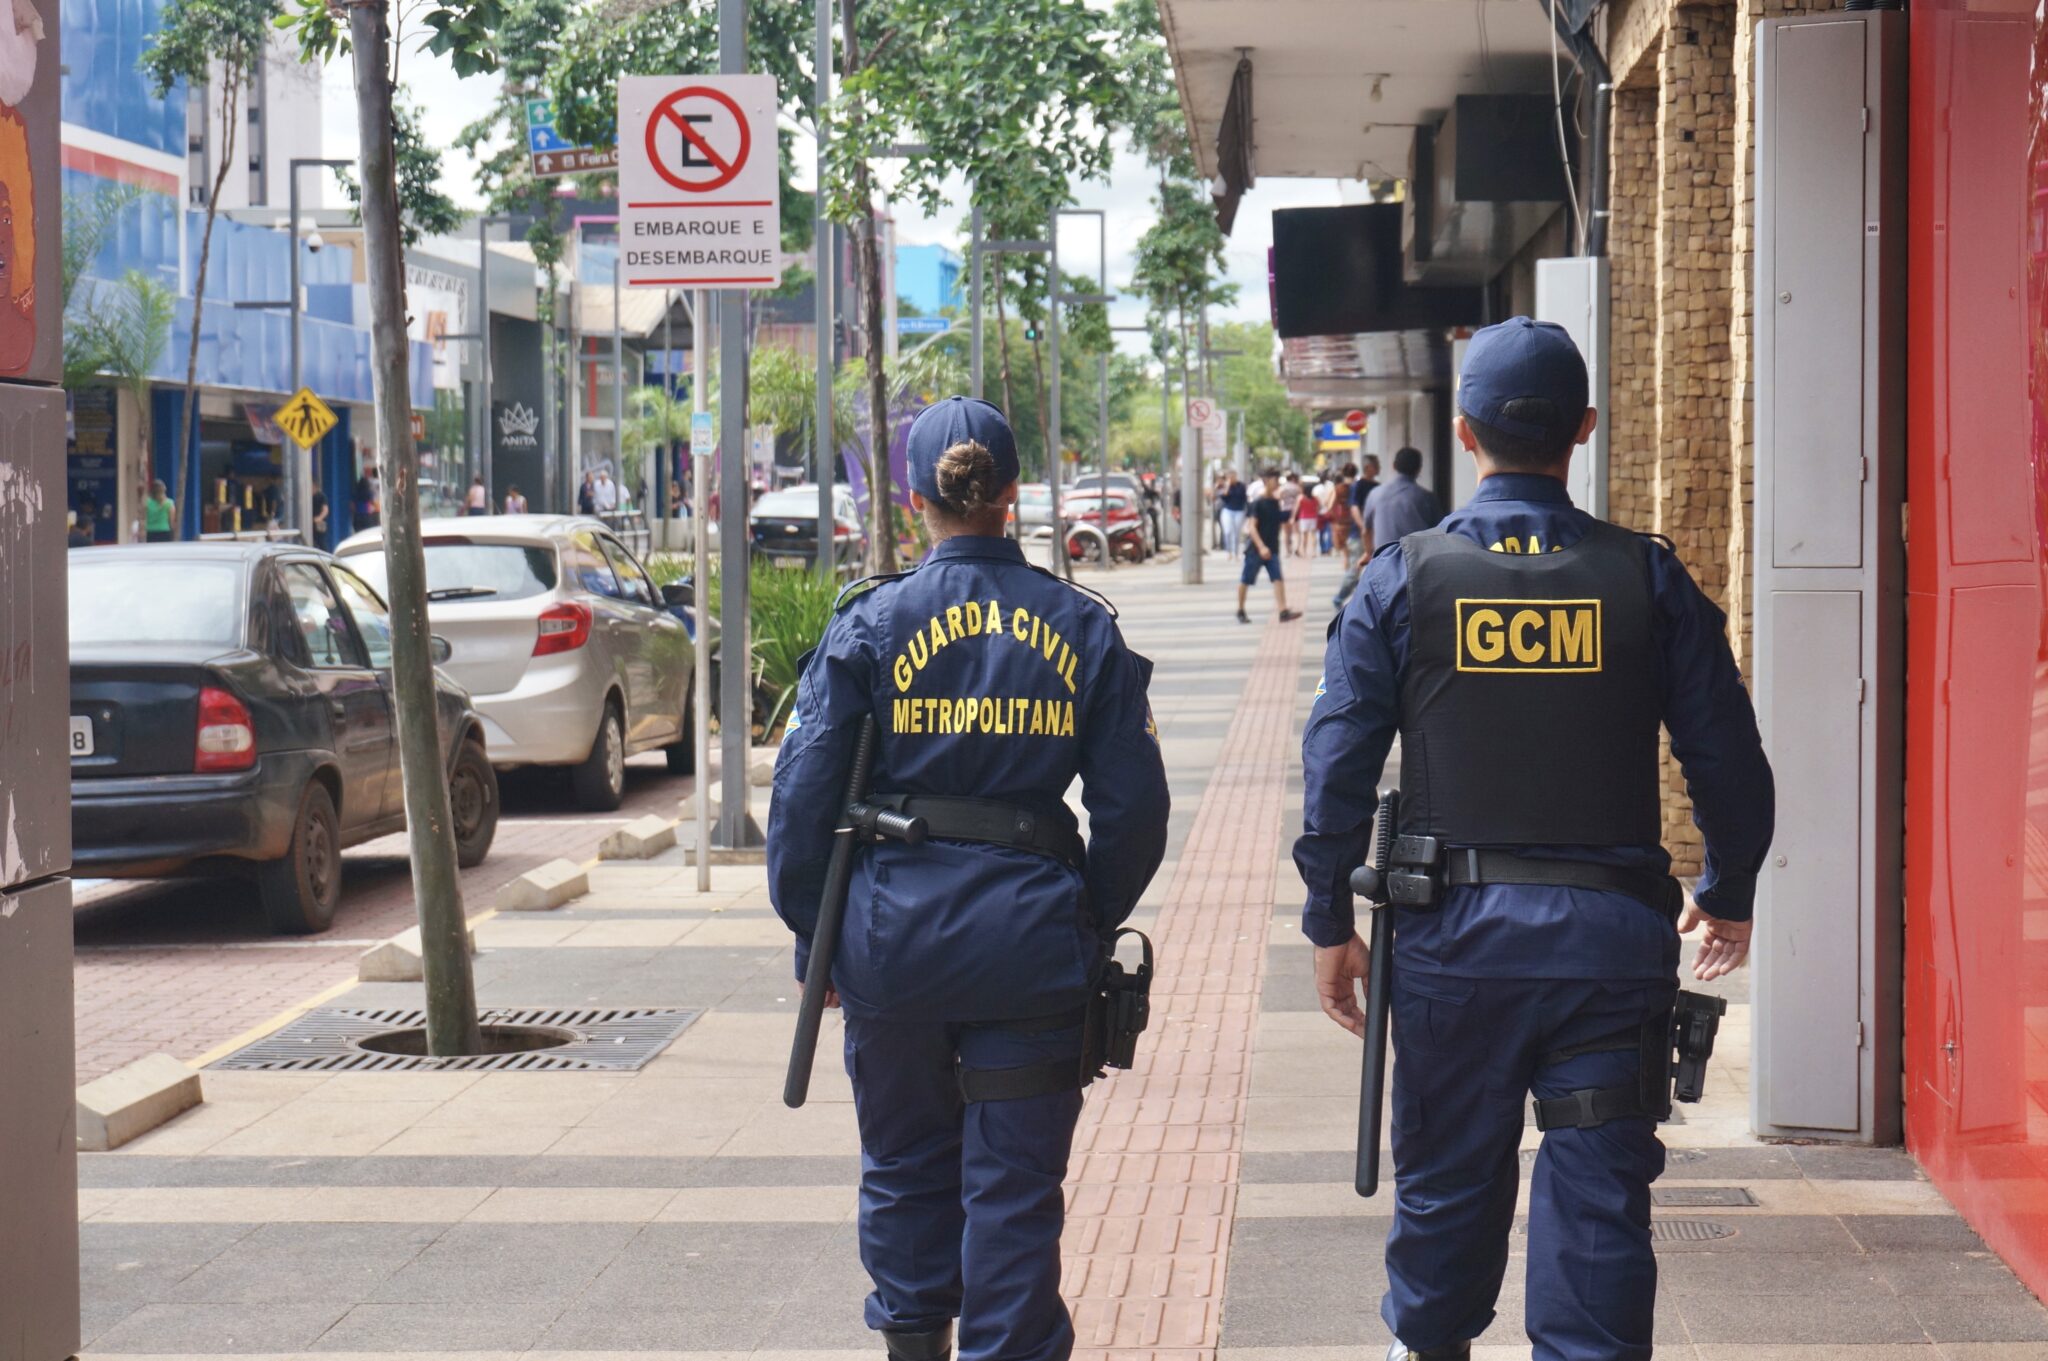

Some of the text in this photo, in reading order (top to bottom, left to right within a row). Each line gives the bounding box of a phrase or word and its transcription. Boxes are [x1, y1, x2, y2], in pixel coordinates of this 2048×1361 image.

[634, 220, 764, 236] EMBARQUE E
[627, 249, 772, 265] DESEMBARQUE
[501, 435, 538, 446] ANITA
[894, 600, 1078, 695] GUARDA CIVIL
[1466, 608, 1594, 663] GCM
[893, 697, 1074, 737] METROPOLITANA
